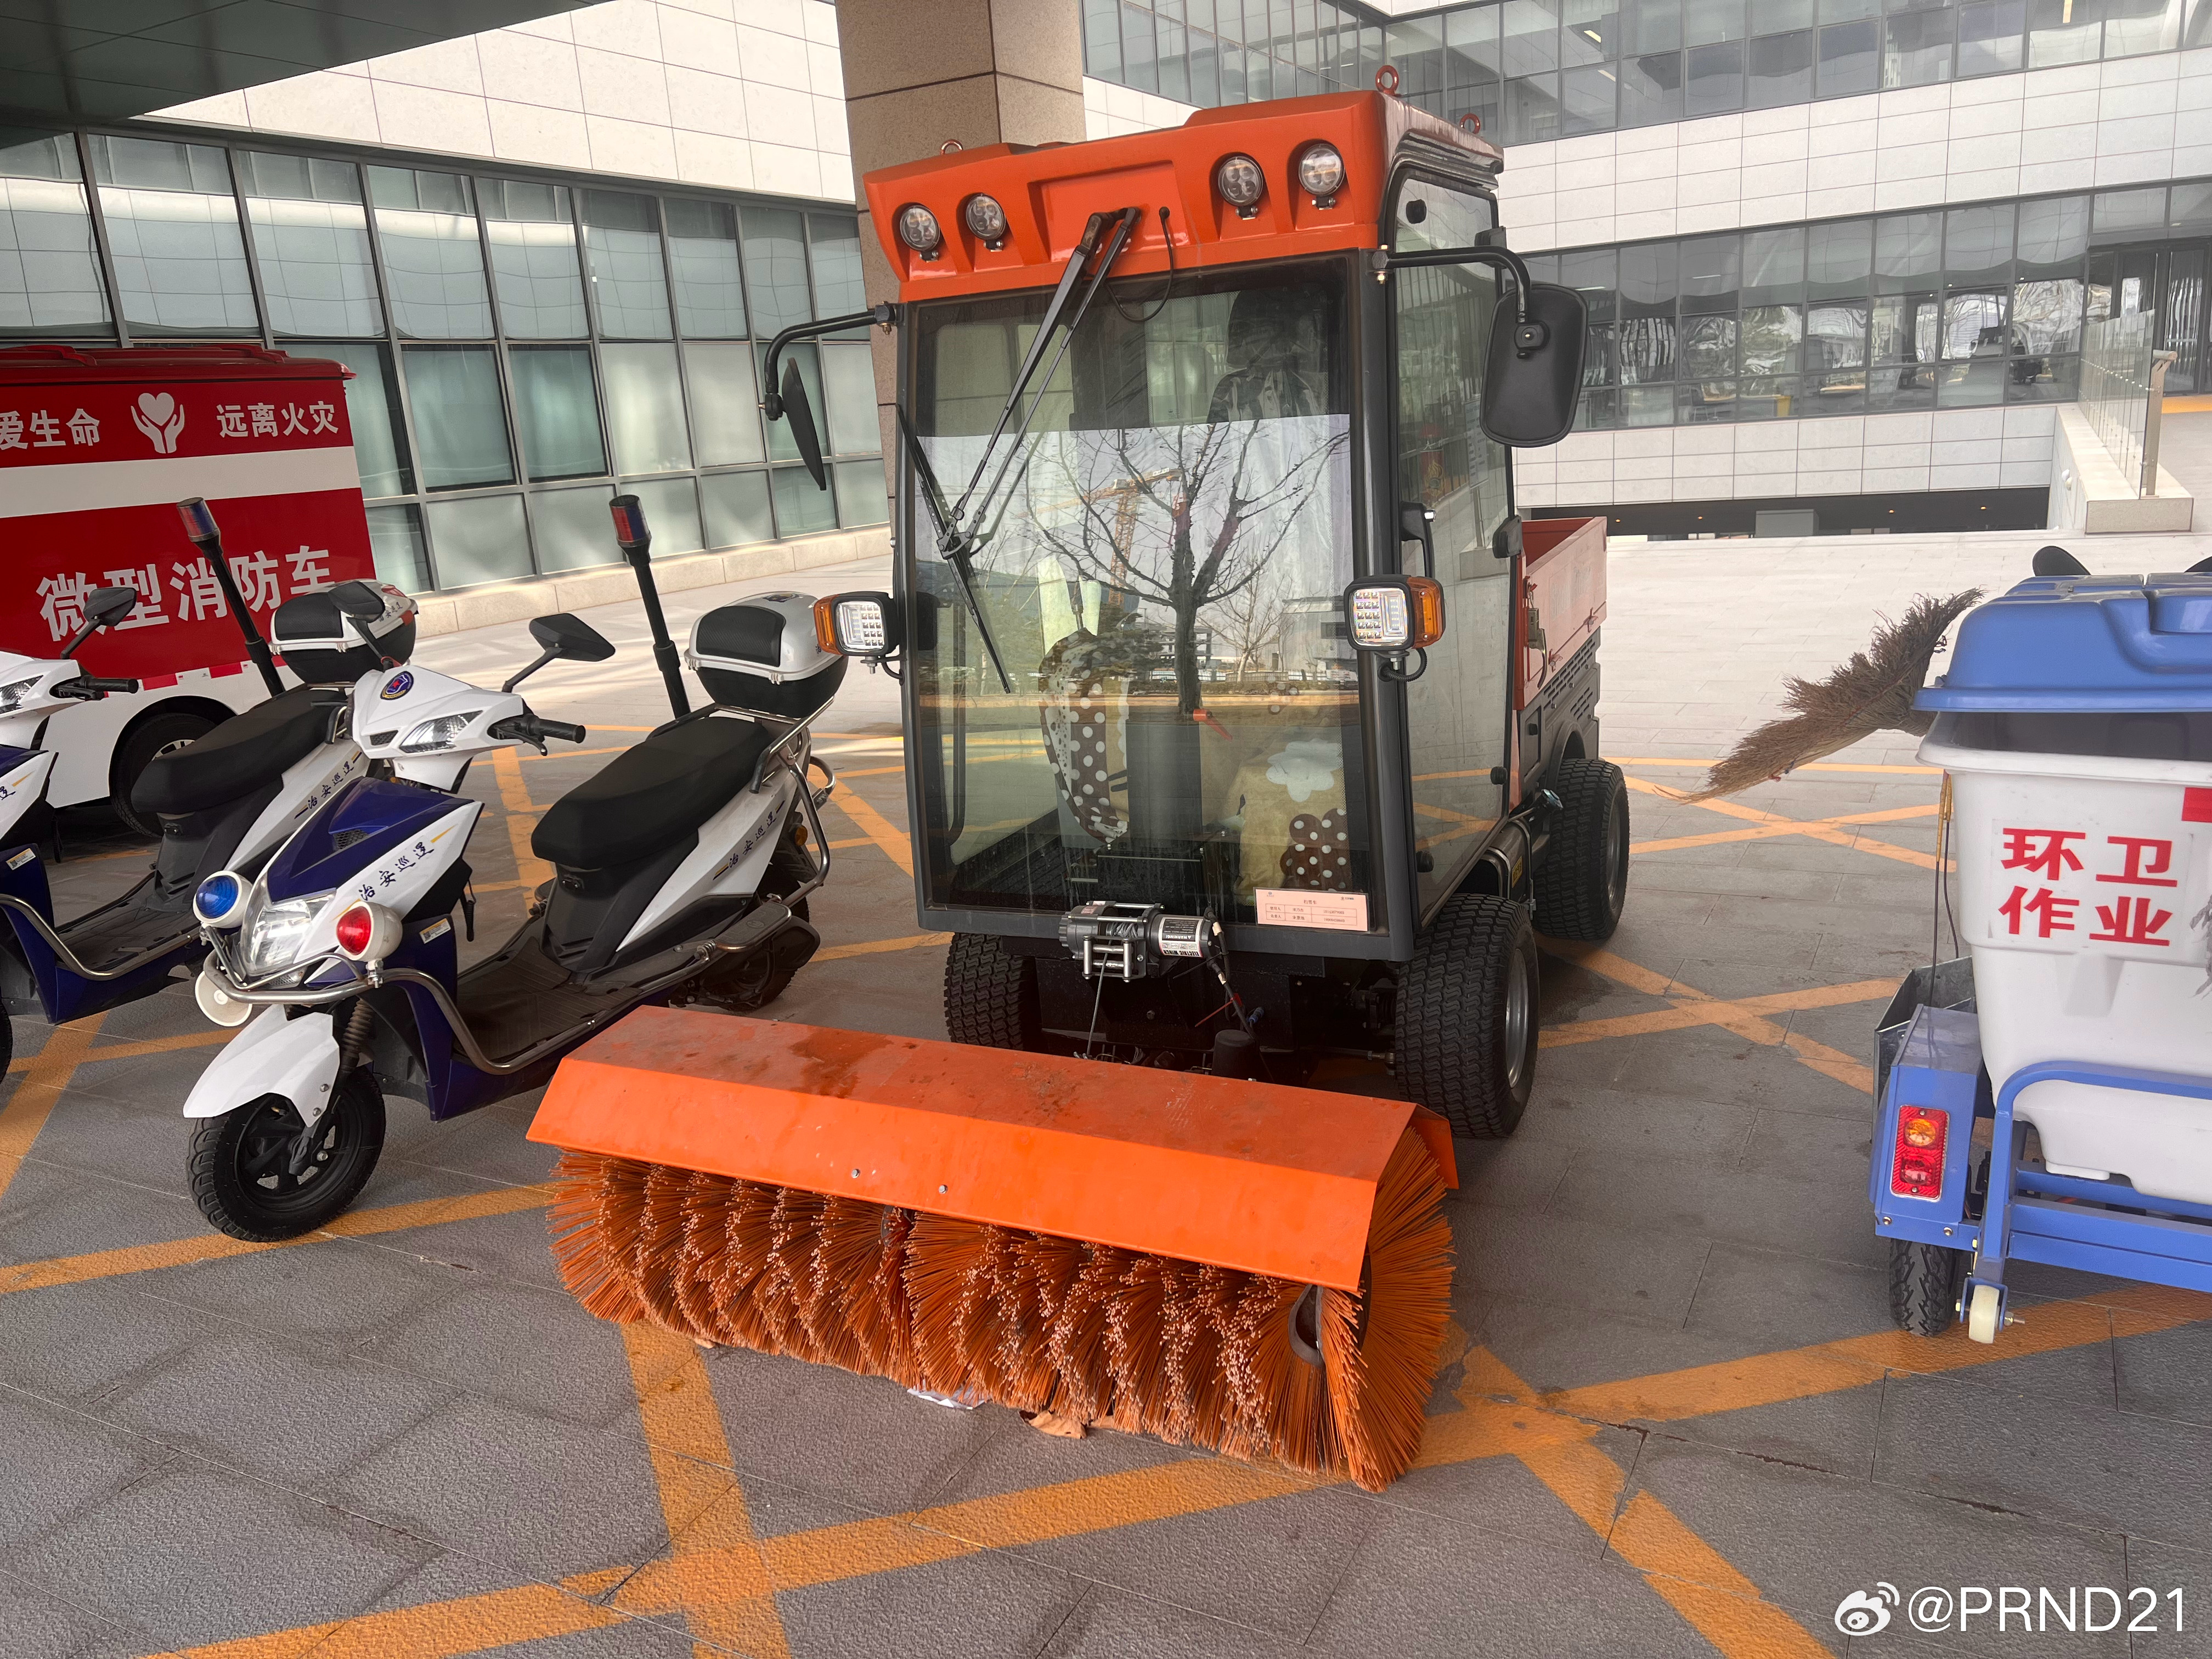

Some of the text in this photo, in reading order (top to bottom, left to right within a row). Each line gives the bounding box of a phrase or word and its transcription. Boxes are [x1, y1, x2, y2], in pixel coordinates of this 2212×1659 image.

[0, 408, 100, 450] 爱生命
[216, 400, 338, 438] 远离火灾
[36, 545, 336, 641] 微型消防车
[308, 761, 354, 809] 治安巡逻
[729, 811, 777, 868] 治安巡逻
[2001, 827, 2178, 888] 环卫
[358, 842, 435, 901] 治安巡逻
[1998, 885, 2173, 947] 作业
